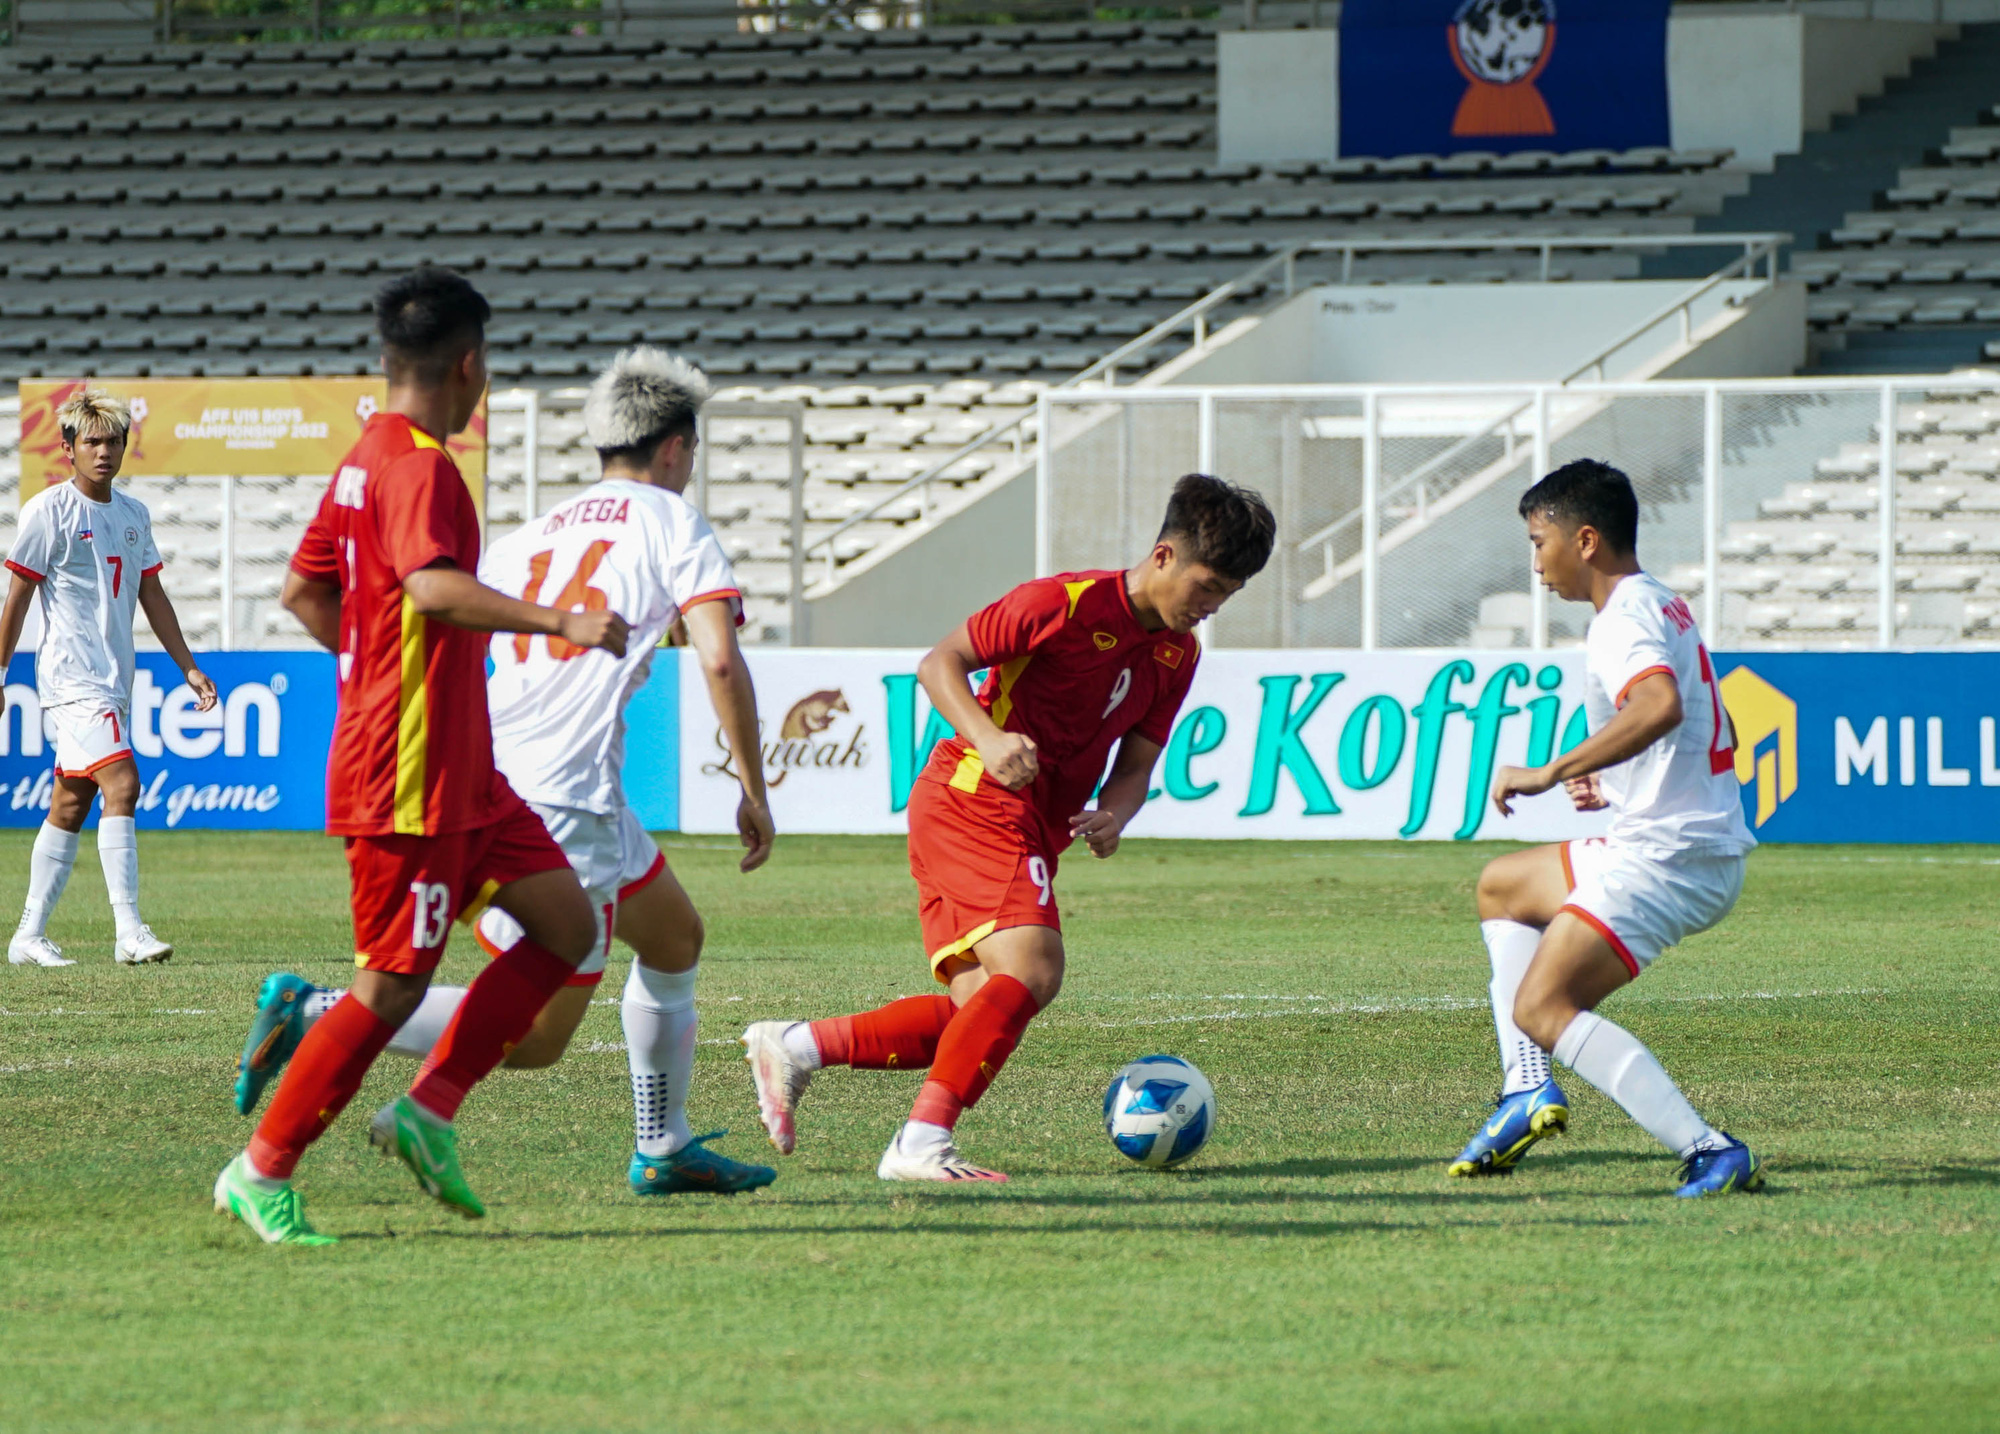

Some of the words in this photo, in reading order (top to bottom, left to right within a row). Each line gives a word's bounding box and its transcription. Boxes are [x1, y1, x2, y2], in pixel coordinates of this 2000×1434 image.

[174, 423, 288, 439] CHAMPIONSHIP
[290, 423, 329, 439] 2022
[106, 556, 123, 599] 7
[512, 539, 617, 666] 16
[1101, 667, 1131, 720] 9
[1237, 659, 1590, 840] Koffi
[11, 767, 53, 811] th
[165, 783, 281, 828] game
[1028, 856, 1050, 906] 9
[411, 882, 450, 949] 13
